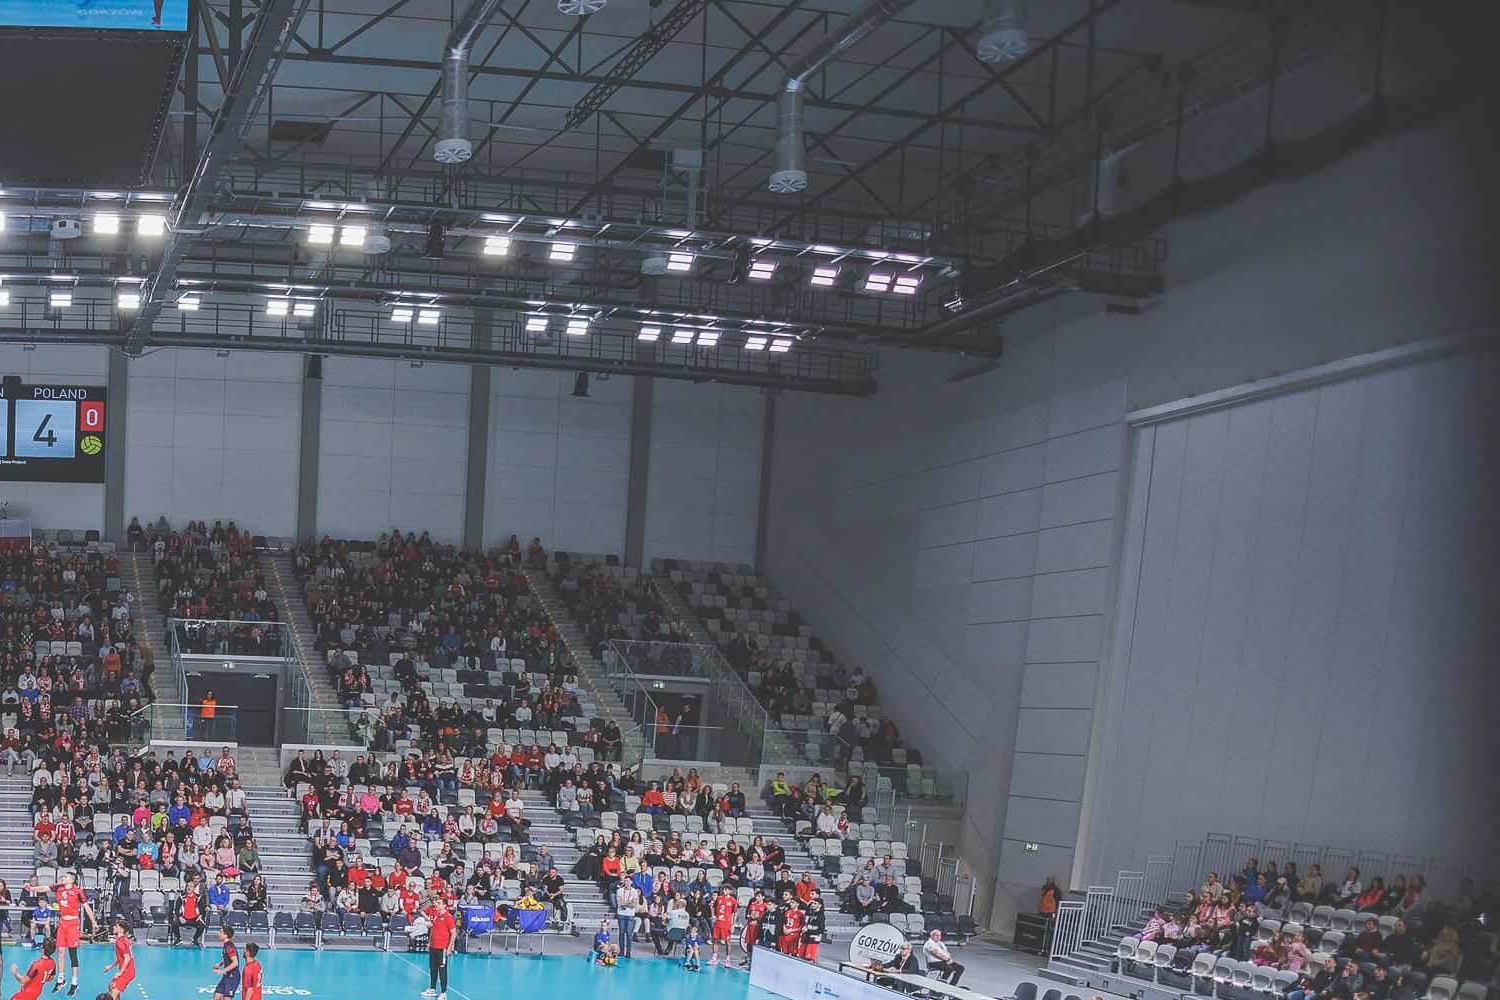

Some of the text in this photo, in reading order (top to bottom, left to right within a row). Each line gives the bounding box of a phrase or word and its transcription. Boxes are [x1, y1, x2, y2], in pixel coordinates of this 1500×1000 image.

[34, 388, 87, 400] POLAND
[85, 408, 99, 426] 0
[33, 414, 57, 447] 4
